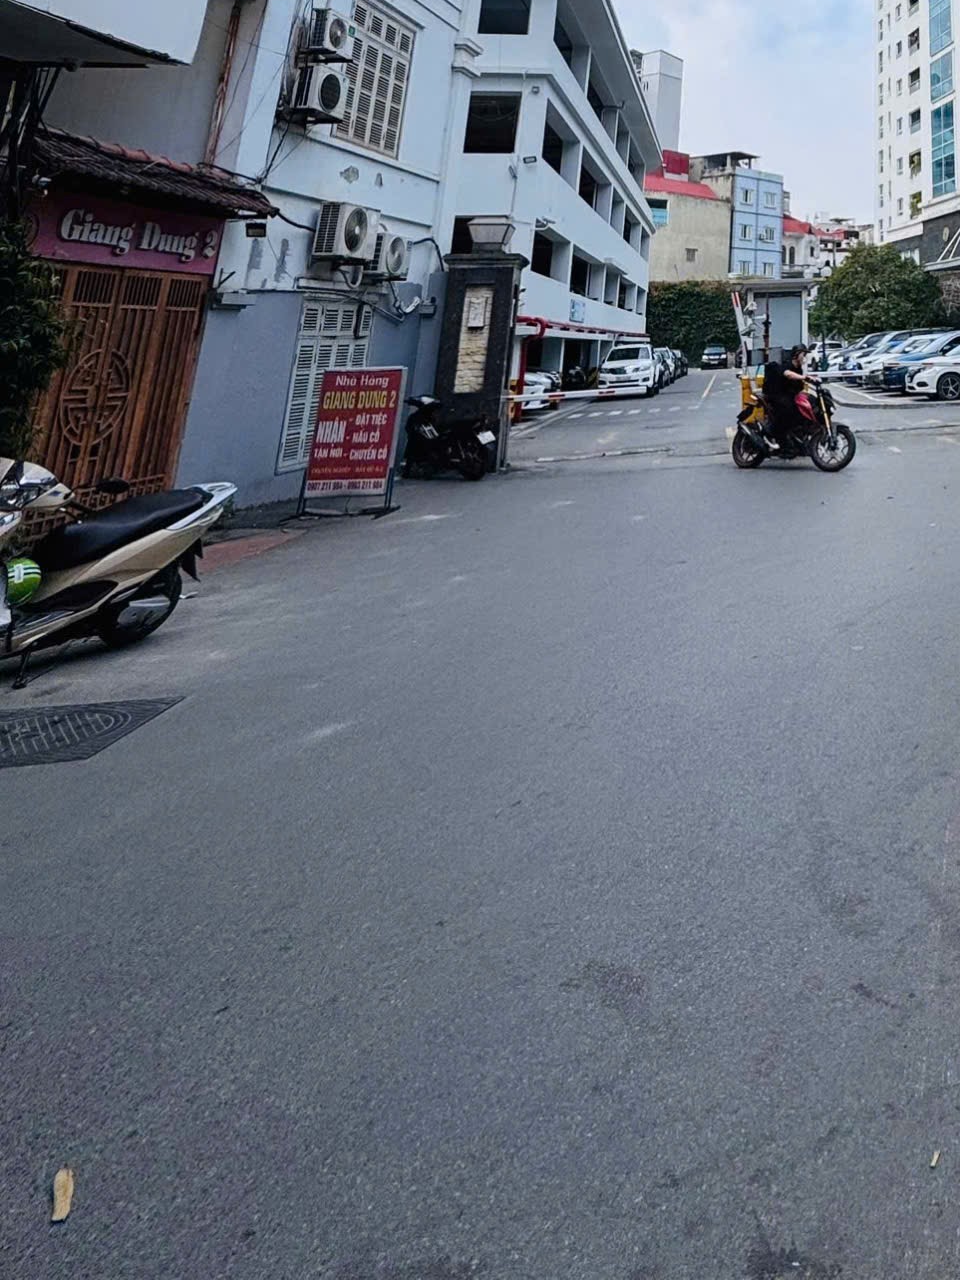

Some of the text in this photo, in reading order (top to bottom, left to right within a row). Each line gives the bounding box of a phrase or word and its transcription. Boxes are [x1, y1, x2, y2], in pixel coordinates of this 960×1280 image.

[60, 209, 218, 262] Giang Dung 2
[336, 374, 389, 388] Nhà Hàng
[323, 390, 396, 409] GIANG DUNG 2
